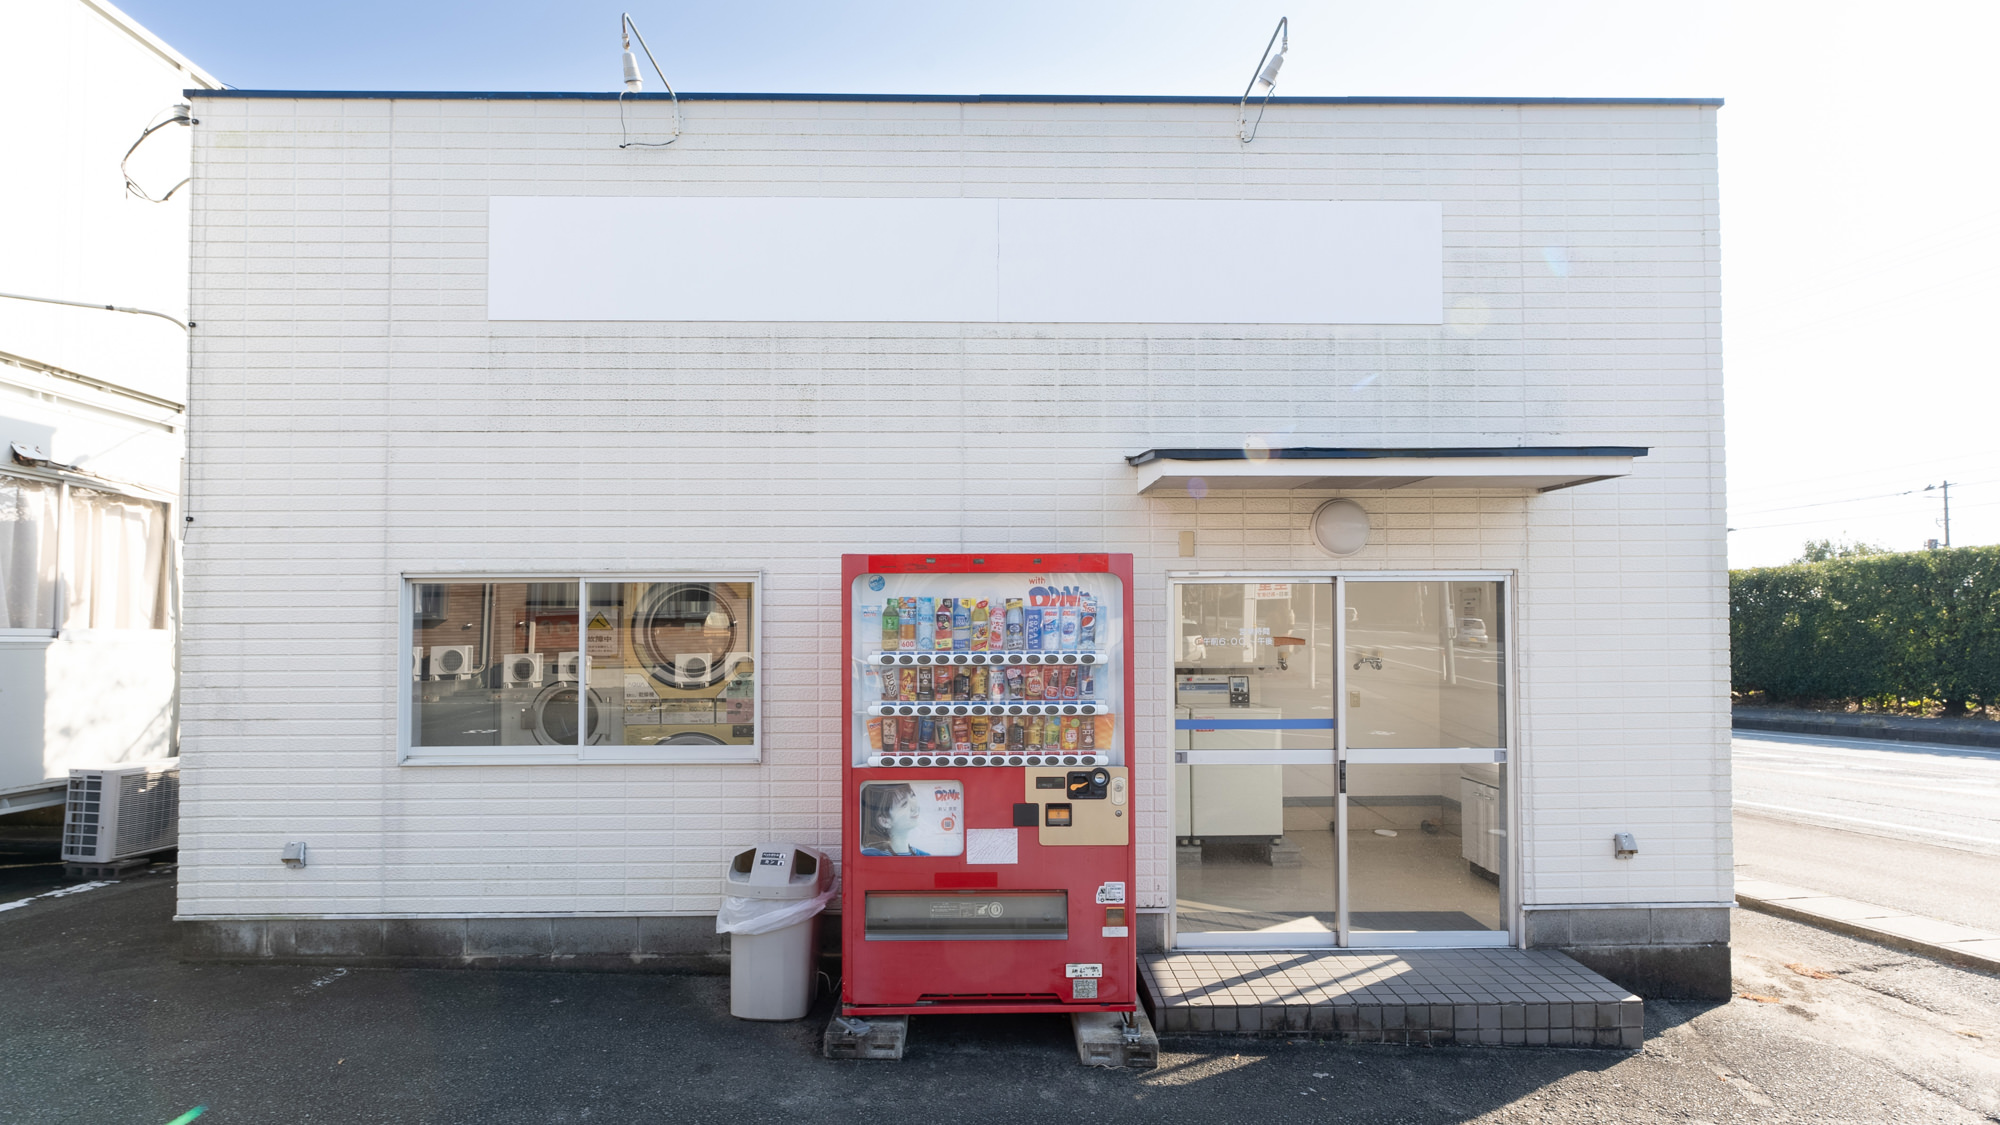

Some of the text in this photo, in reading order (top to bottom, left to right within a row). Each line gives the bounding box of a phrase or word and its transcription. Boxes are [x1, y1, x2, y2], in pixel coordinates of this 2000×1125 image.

[1029, 576, 1046, 585] with
[587, 635, 612, 643] 故障中
[886, 672, 897, 697] BOSS
